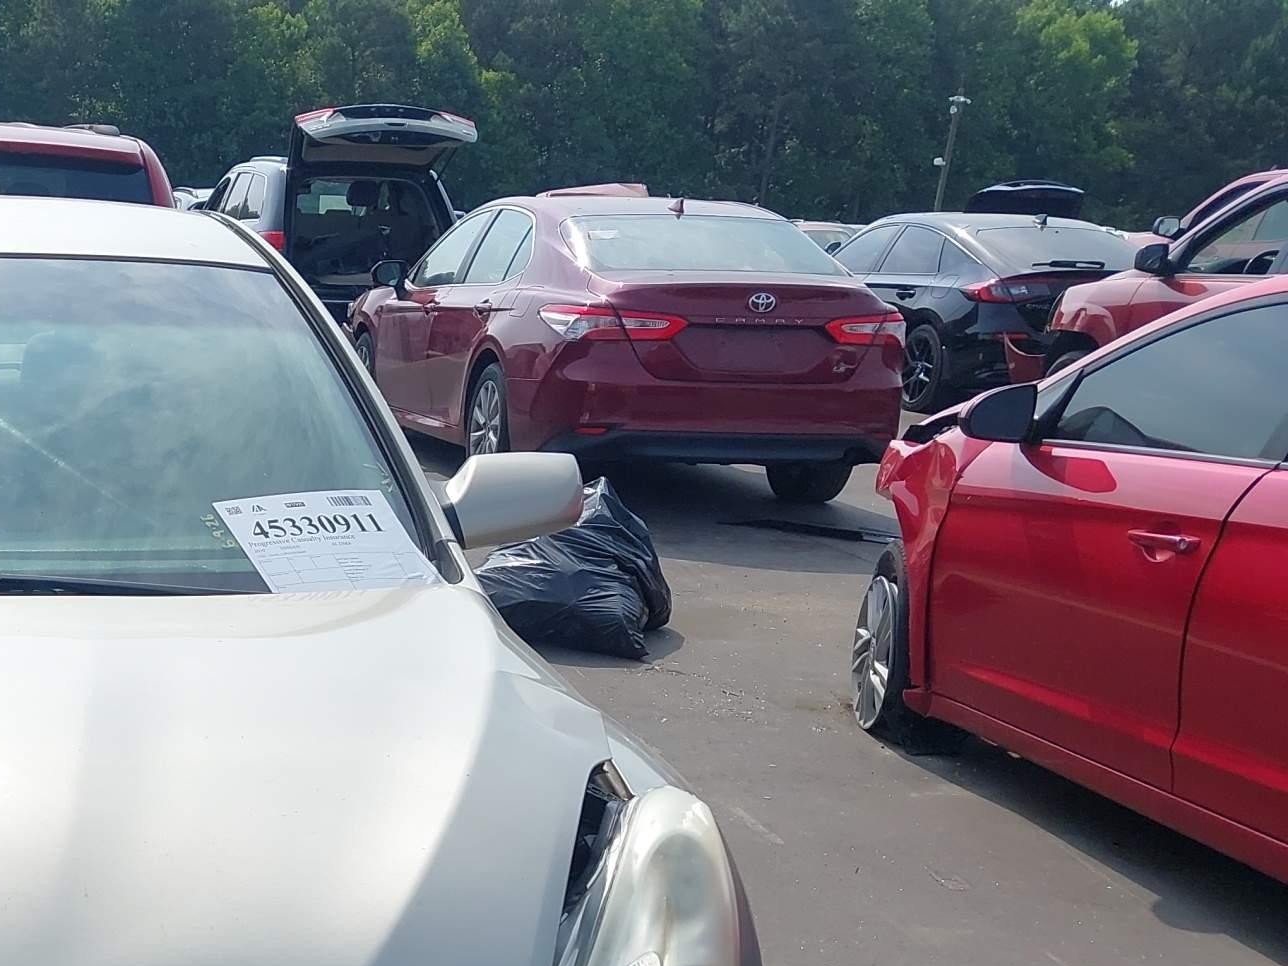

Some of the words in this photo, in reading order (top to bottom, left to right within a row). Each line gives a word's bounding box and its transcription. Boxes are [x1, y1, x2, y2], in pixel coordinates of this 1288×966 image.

[253, 513, 385, 538] 45330911
[248, 539, 290, 548] Progressive
[290, 536, 322, 544] Casualty
[322, 534, 356, 542] Insurance
